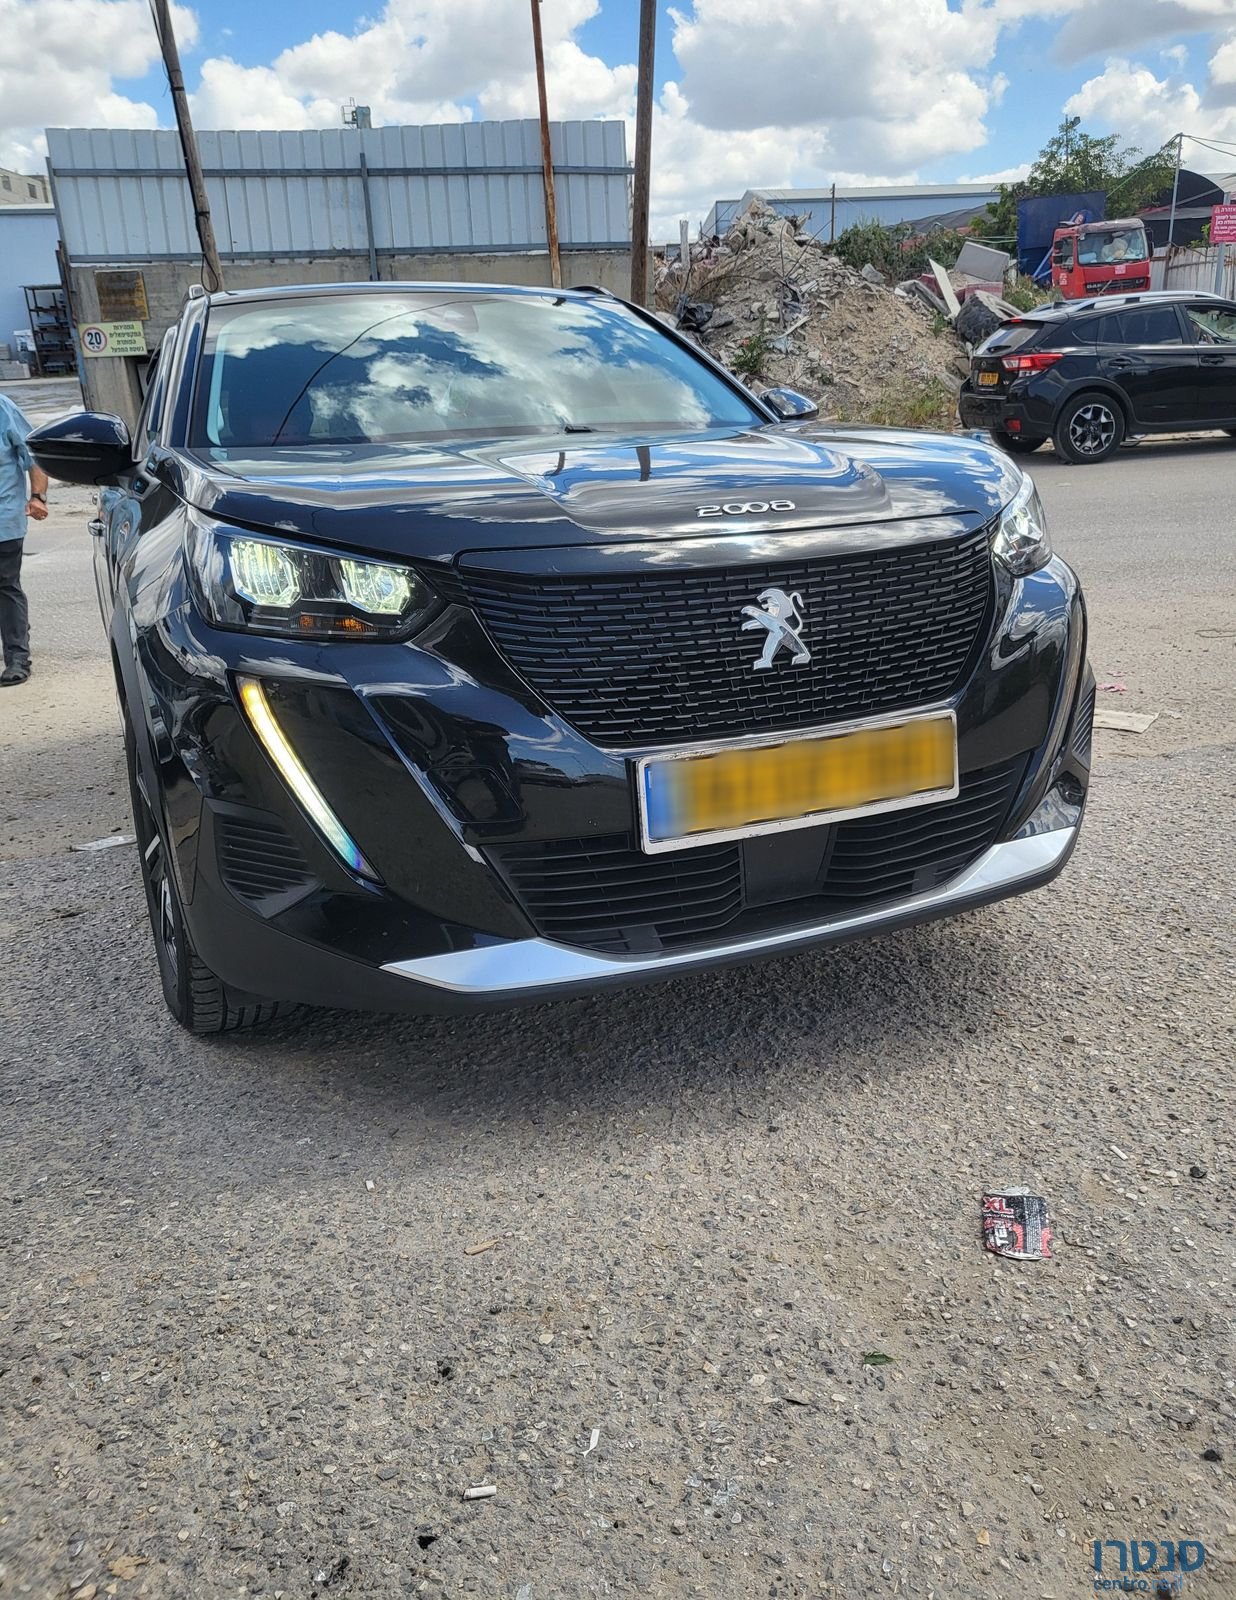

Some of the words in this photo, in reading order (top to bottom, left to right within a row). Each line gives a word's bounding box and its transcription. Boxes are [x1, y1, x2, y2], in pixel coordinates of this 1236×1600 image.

[87, 332, 102, 345] 20
[695, 499, 796, 518] 2008
[981, 1196, 1015, 1214] XL
